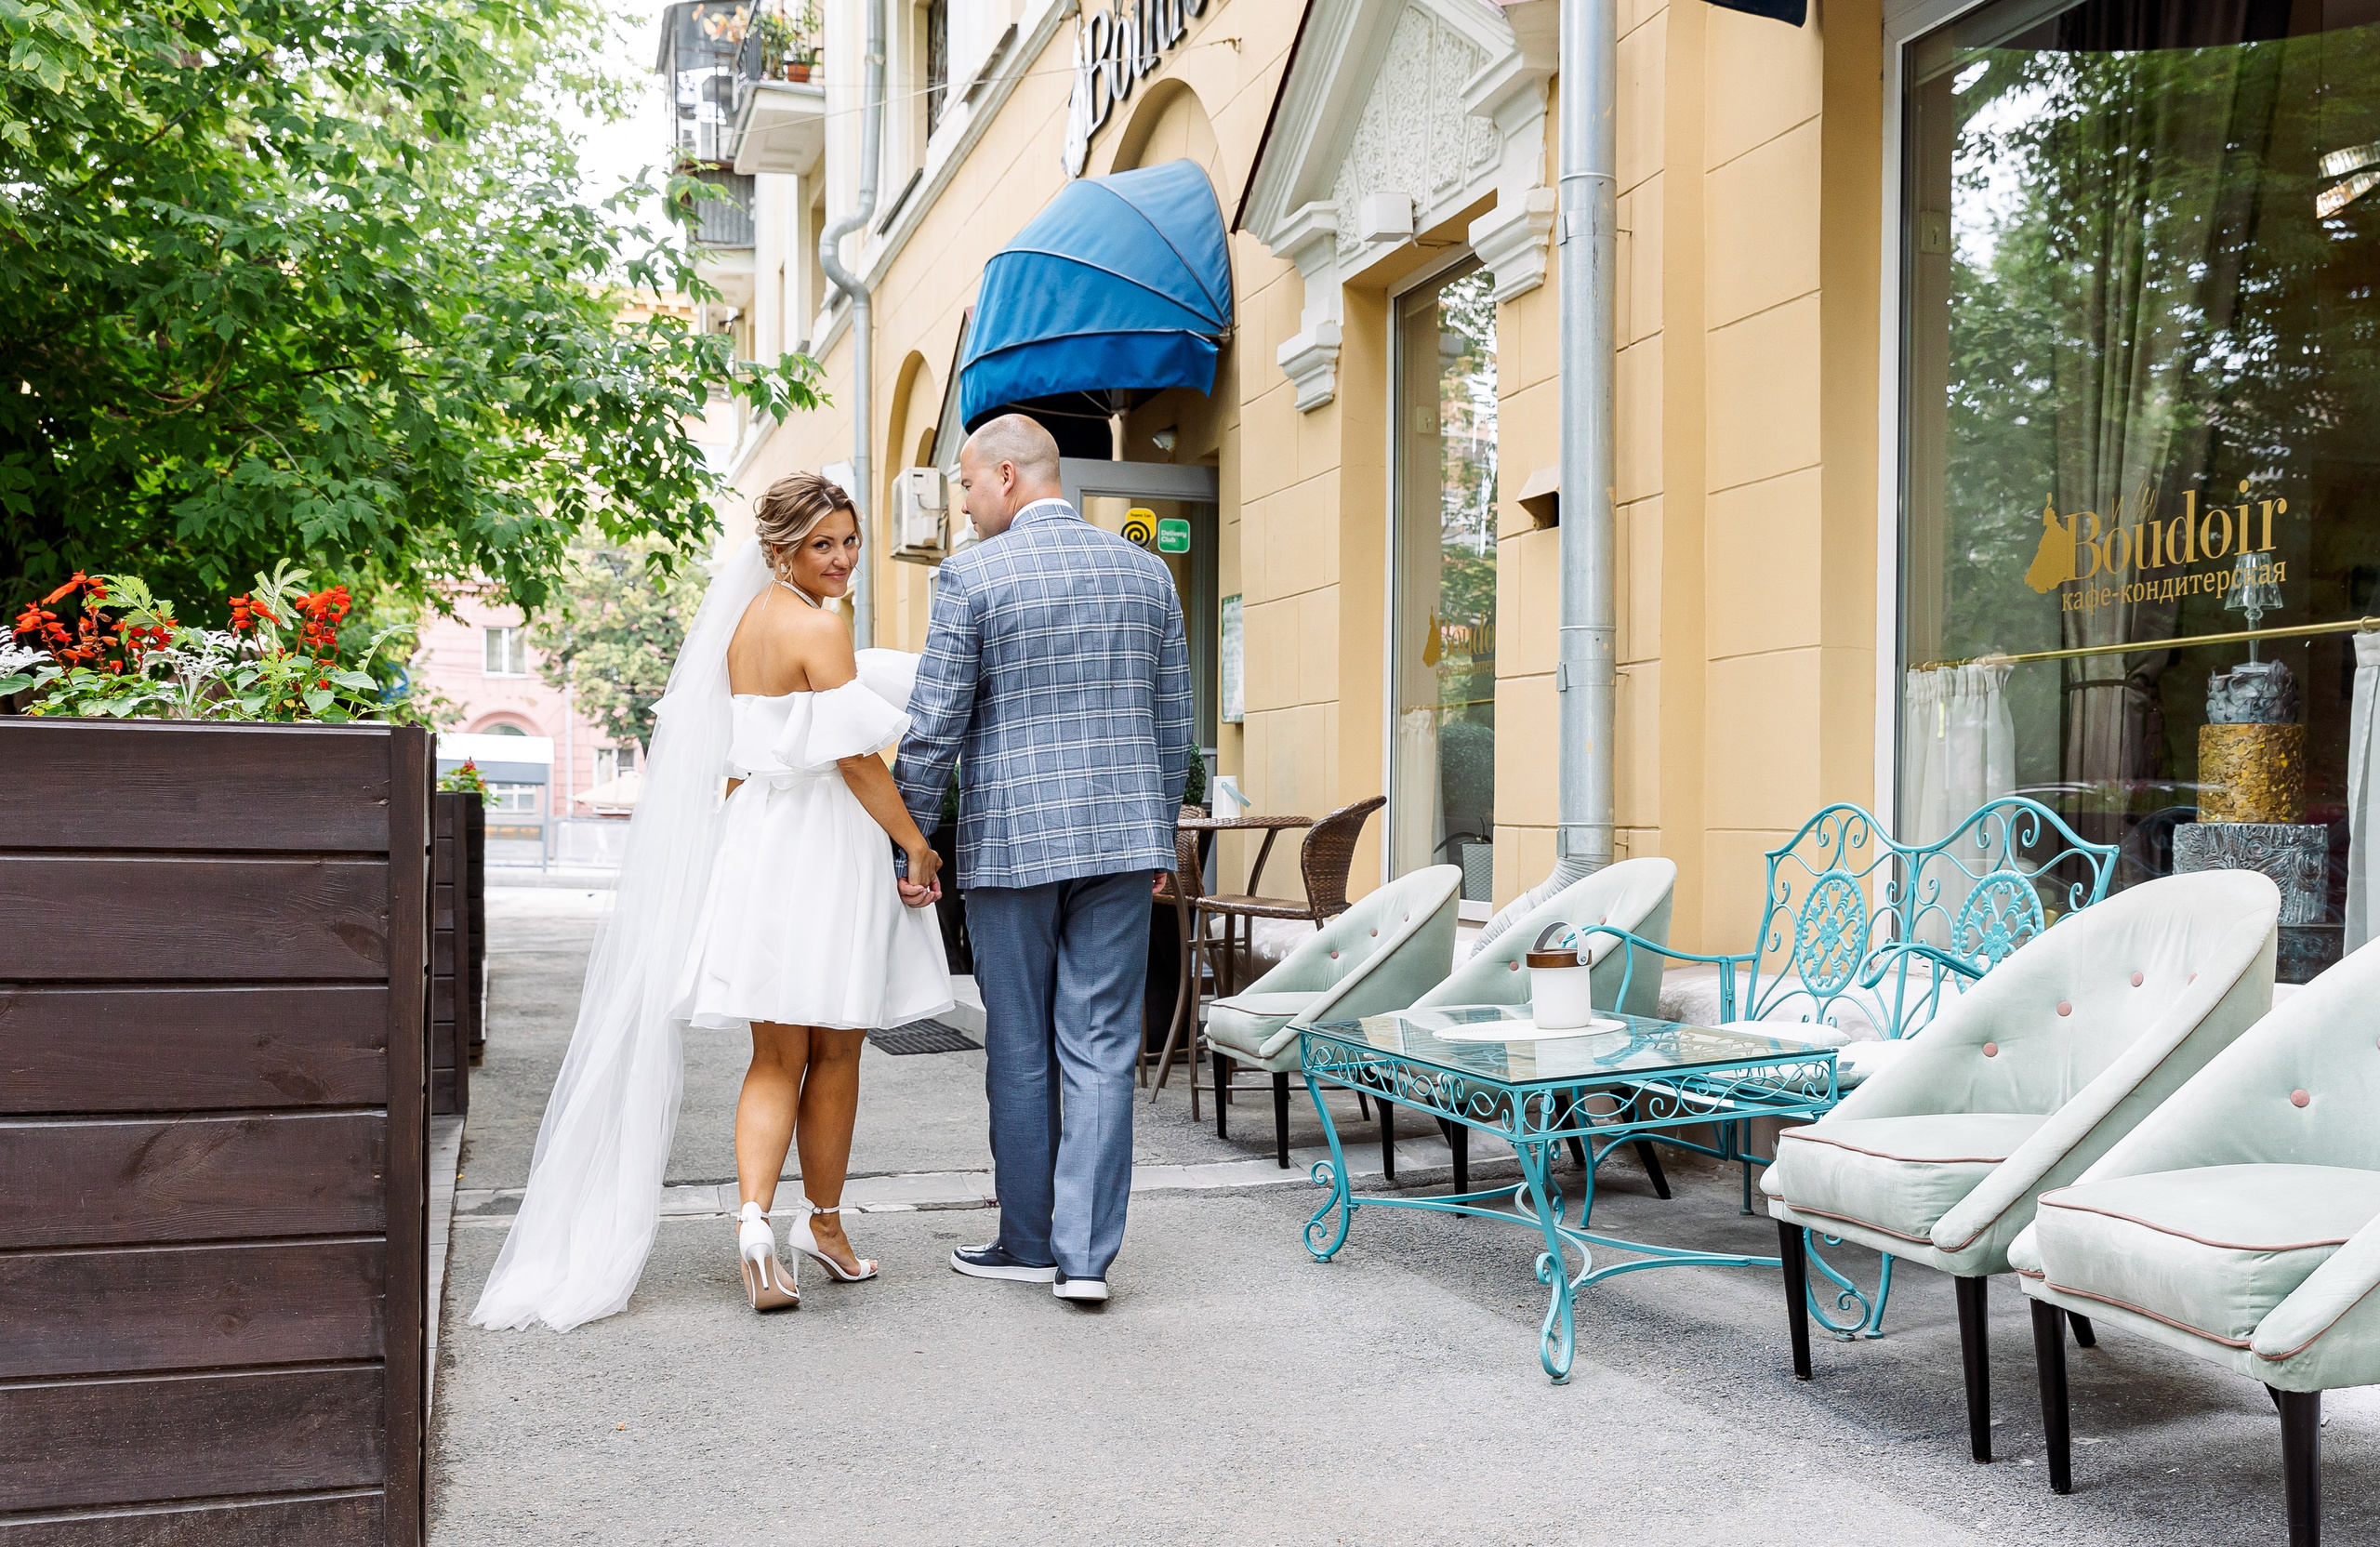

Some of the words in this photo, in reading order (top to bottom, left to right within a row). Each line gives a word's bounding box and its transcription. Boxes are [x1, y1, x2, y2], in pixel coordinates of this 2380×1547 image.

[1161, 530, 1187, 538] Delivery
[2061, 480, 2287, 582] Boudoir
[2061, 561, 2286, 615] кафе-кондитерская
